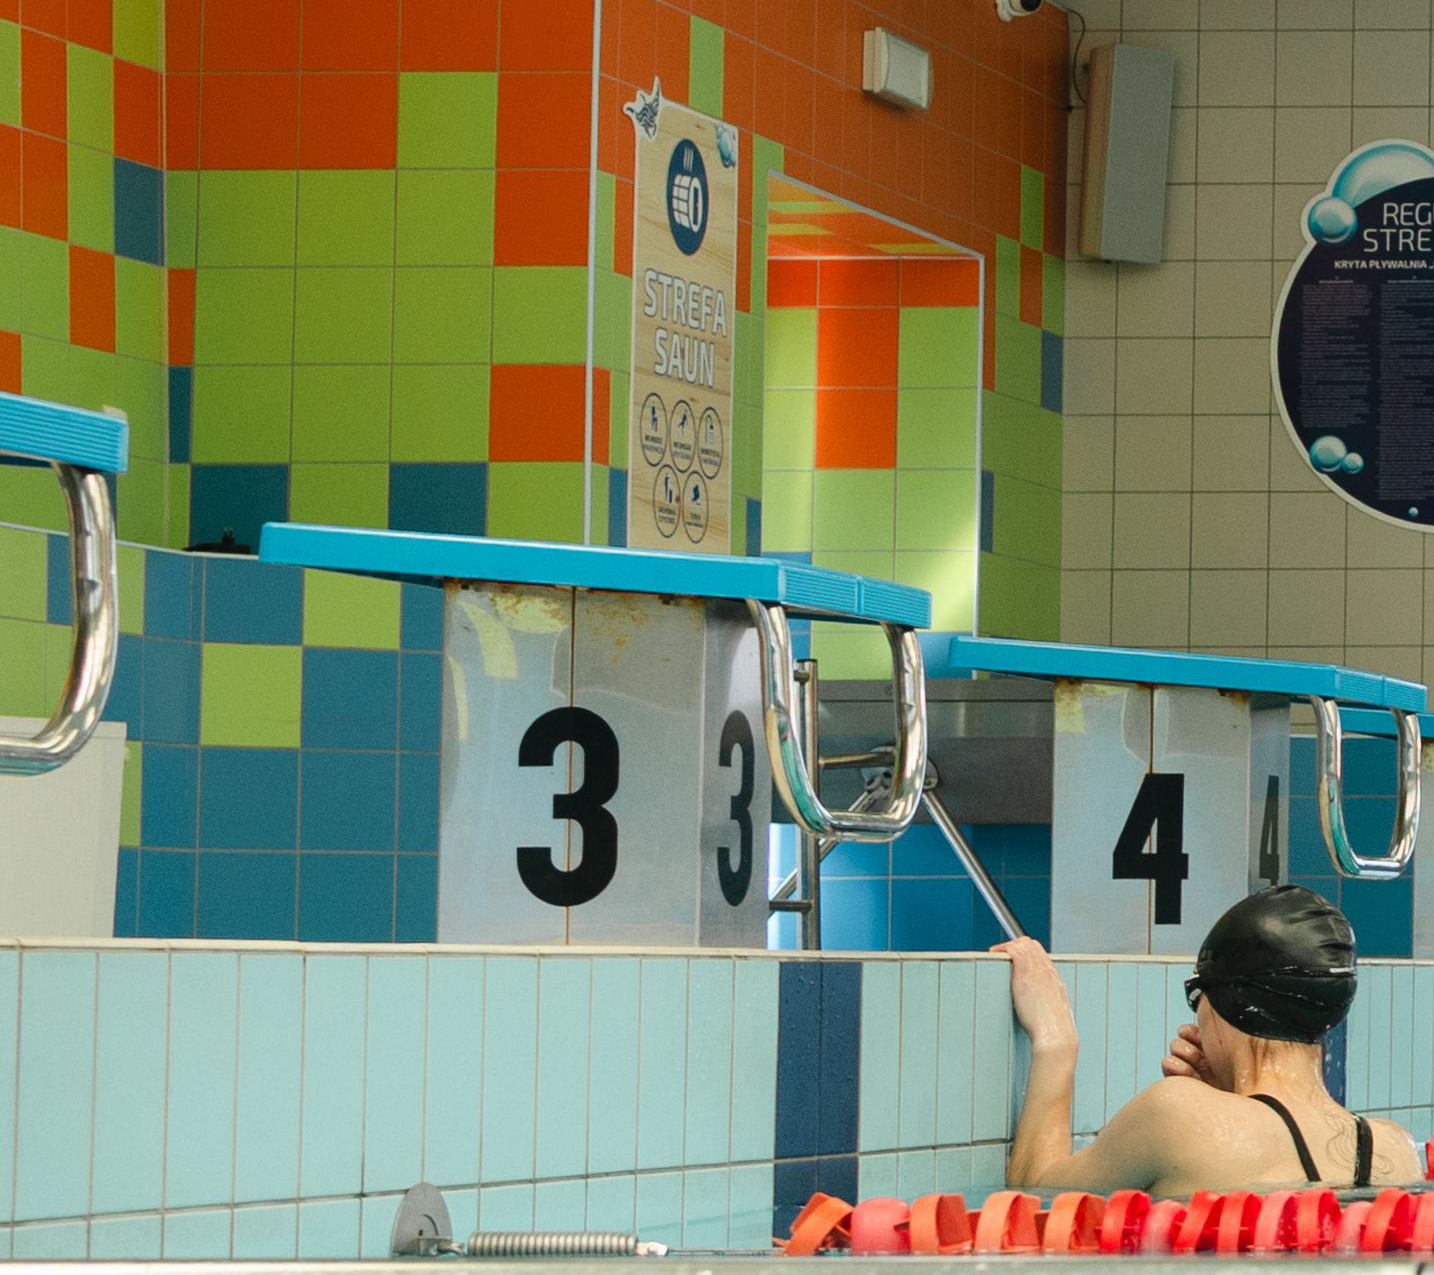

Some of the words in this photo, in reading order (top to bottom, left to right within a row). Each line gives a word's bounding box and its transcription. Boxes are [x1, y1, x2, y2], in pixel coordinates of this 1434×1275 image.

[644, 268, 727, 338] STREFA
[1334, 260, 1368, 270] KRYTA
[1368, 259, 1427, 270] PŁYWALNIA
[653, 326, 714, 388] SAUN
[516, 706, 620, 906] 3
[716, 709, 756, 907] 3
[1112, 773, 1189, 925] 4
[1259, 774, 1280, 885] 4
